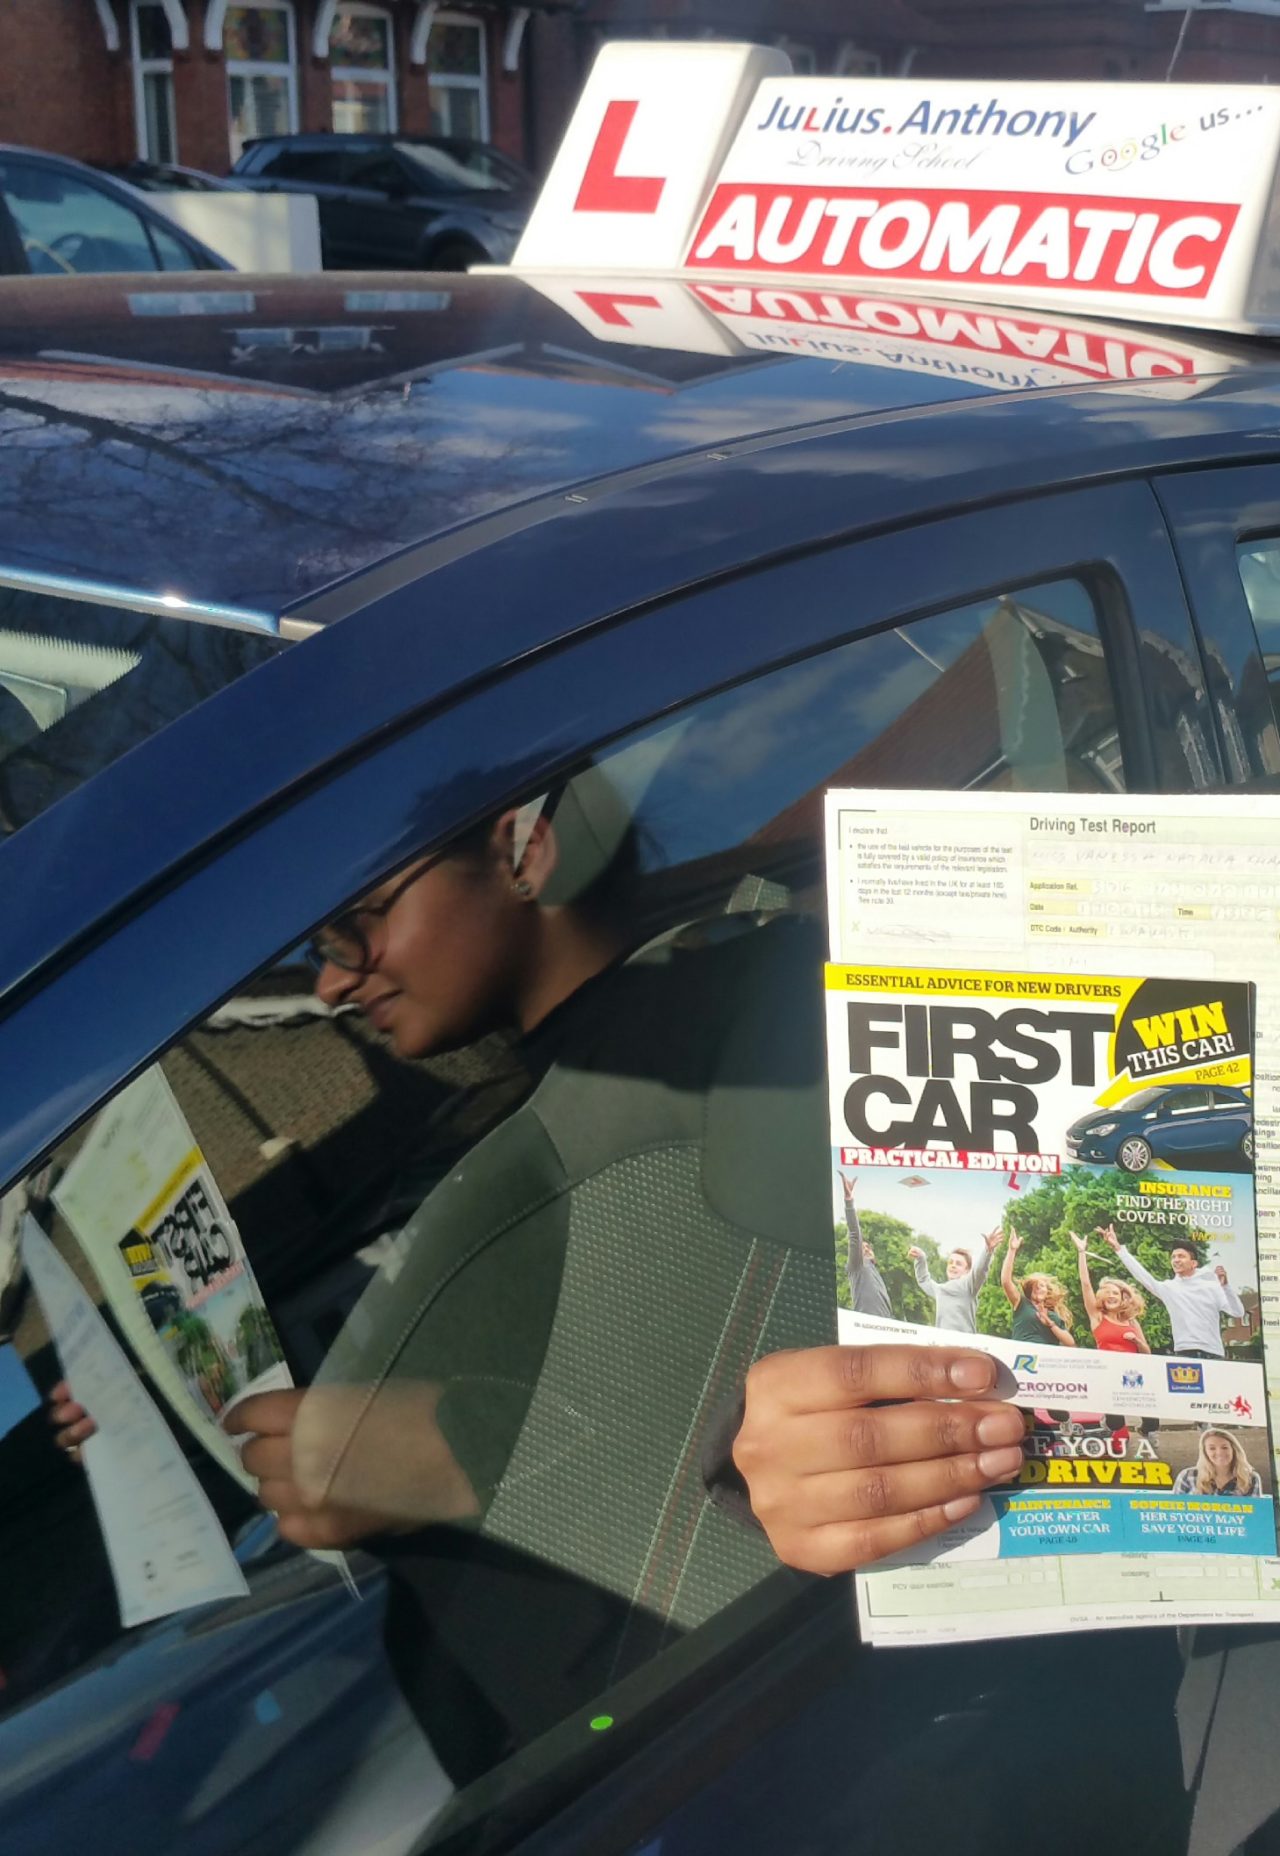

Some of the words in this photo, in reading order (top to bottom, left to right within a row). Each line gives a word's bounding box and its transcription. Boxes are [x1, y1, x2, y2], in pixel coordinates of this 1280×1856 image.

[573, 99, 667, 213] L
[1064, 122, 1187, 175] Google
[694, 194, 1222, 290] AUTOMATIC
[1030, 817, 1075, 834] Driving
[1079, 818, 1107, 833] Test
[1112, 820, 1156, 836] Report
[846, 973, 924, 988] ESSENTIAL
[927, 976, 981, 991] ADVICE
[985, 979, 1015, 993] FOR
[1018, 981, 1051, 994] NEW
[1054, 983, 1122, 997] DRIVERS
[1132, 1001, 1229, 1050] WIN
[847, 1000, 1116, 1087] FIRST
[1127, 1046, 1181, 1073] THIS
[1183, 1033, 1236, 1060] CAR!
[1195, 1066, 1225, 1080] PAGE
[1227, 1063, 1240, 1075] 42
[843, 1074, 1039, 1154] CAR
[844, 1146, 964, 1169] PRACTICAL
[967, 1153, 1058, 1174] EDITION
[1139, 1181, 1232, 1198] INSURANCE
[1116, 1195, 1151, 1208] FIND
[1154, 1197, 1183, 1211] THE
[1185, 1199, 1232, 1212] RIGHT
[1116, 1210, 1166, 1224] COVER
[1169, 1213, 1198, 1226] FOR
[1201, 1215, 1232, 1227] YOU
[1017, 1381, 1088, 1393] CROYDON
[1190, 1402, 1230, 1410] ENFIELD
[1061, 1436, 1129, 1459] YOU
[1135, 1438, 1158, 1460] A
[1021, 1459, 1173, 1485] DRIVER
[1017, 1512, 1053, 1523] LOOK
[1057, 1511, 1100, 1521] AFTER
[1140, 1512, 1165, 1522] HER
[1169, 1513, 1212, 1523] STORY
[1215, 1515, 1245, 1525] MAY
[1009, 1526, 1045, 1537] YOUR
[1048, 1524, 1081, 1535] OWN
[1083, 1523, 1110, 1533] CAR
[1141, 1523, 1175, 1534] SAVE
[1177, 1524, 1216, 1535] YOUR
[1218, 1526, 1246, 1537] LIFE
